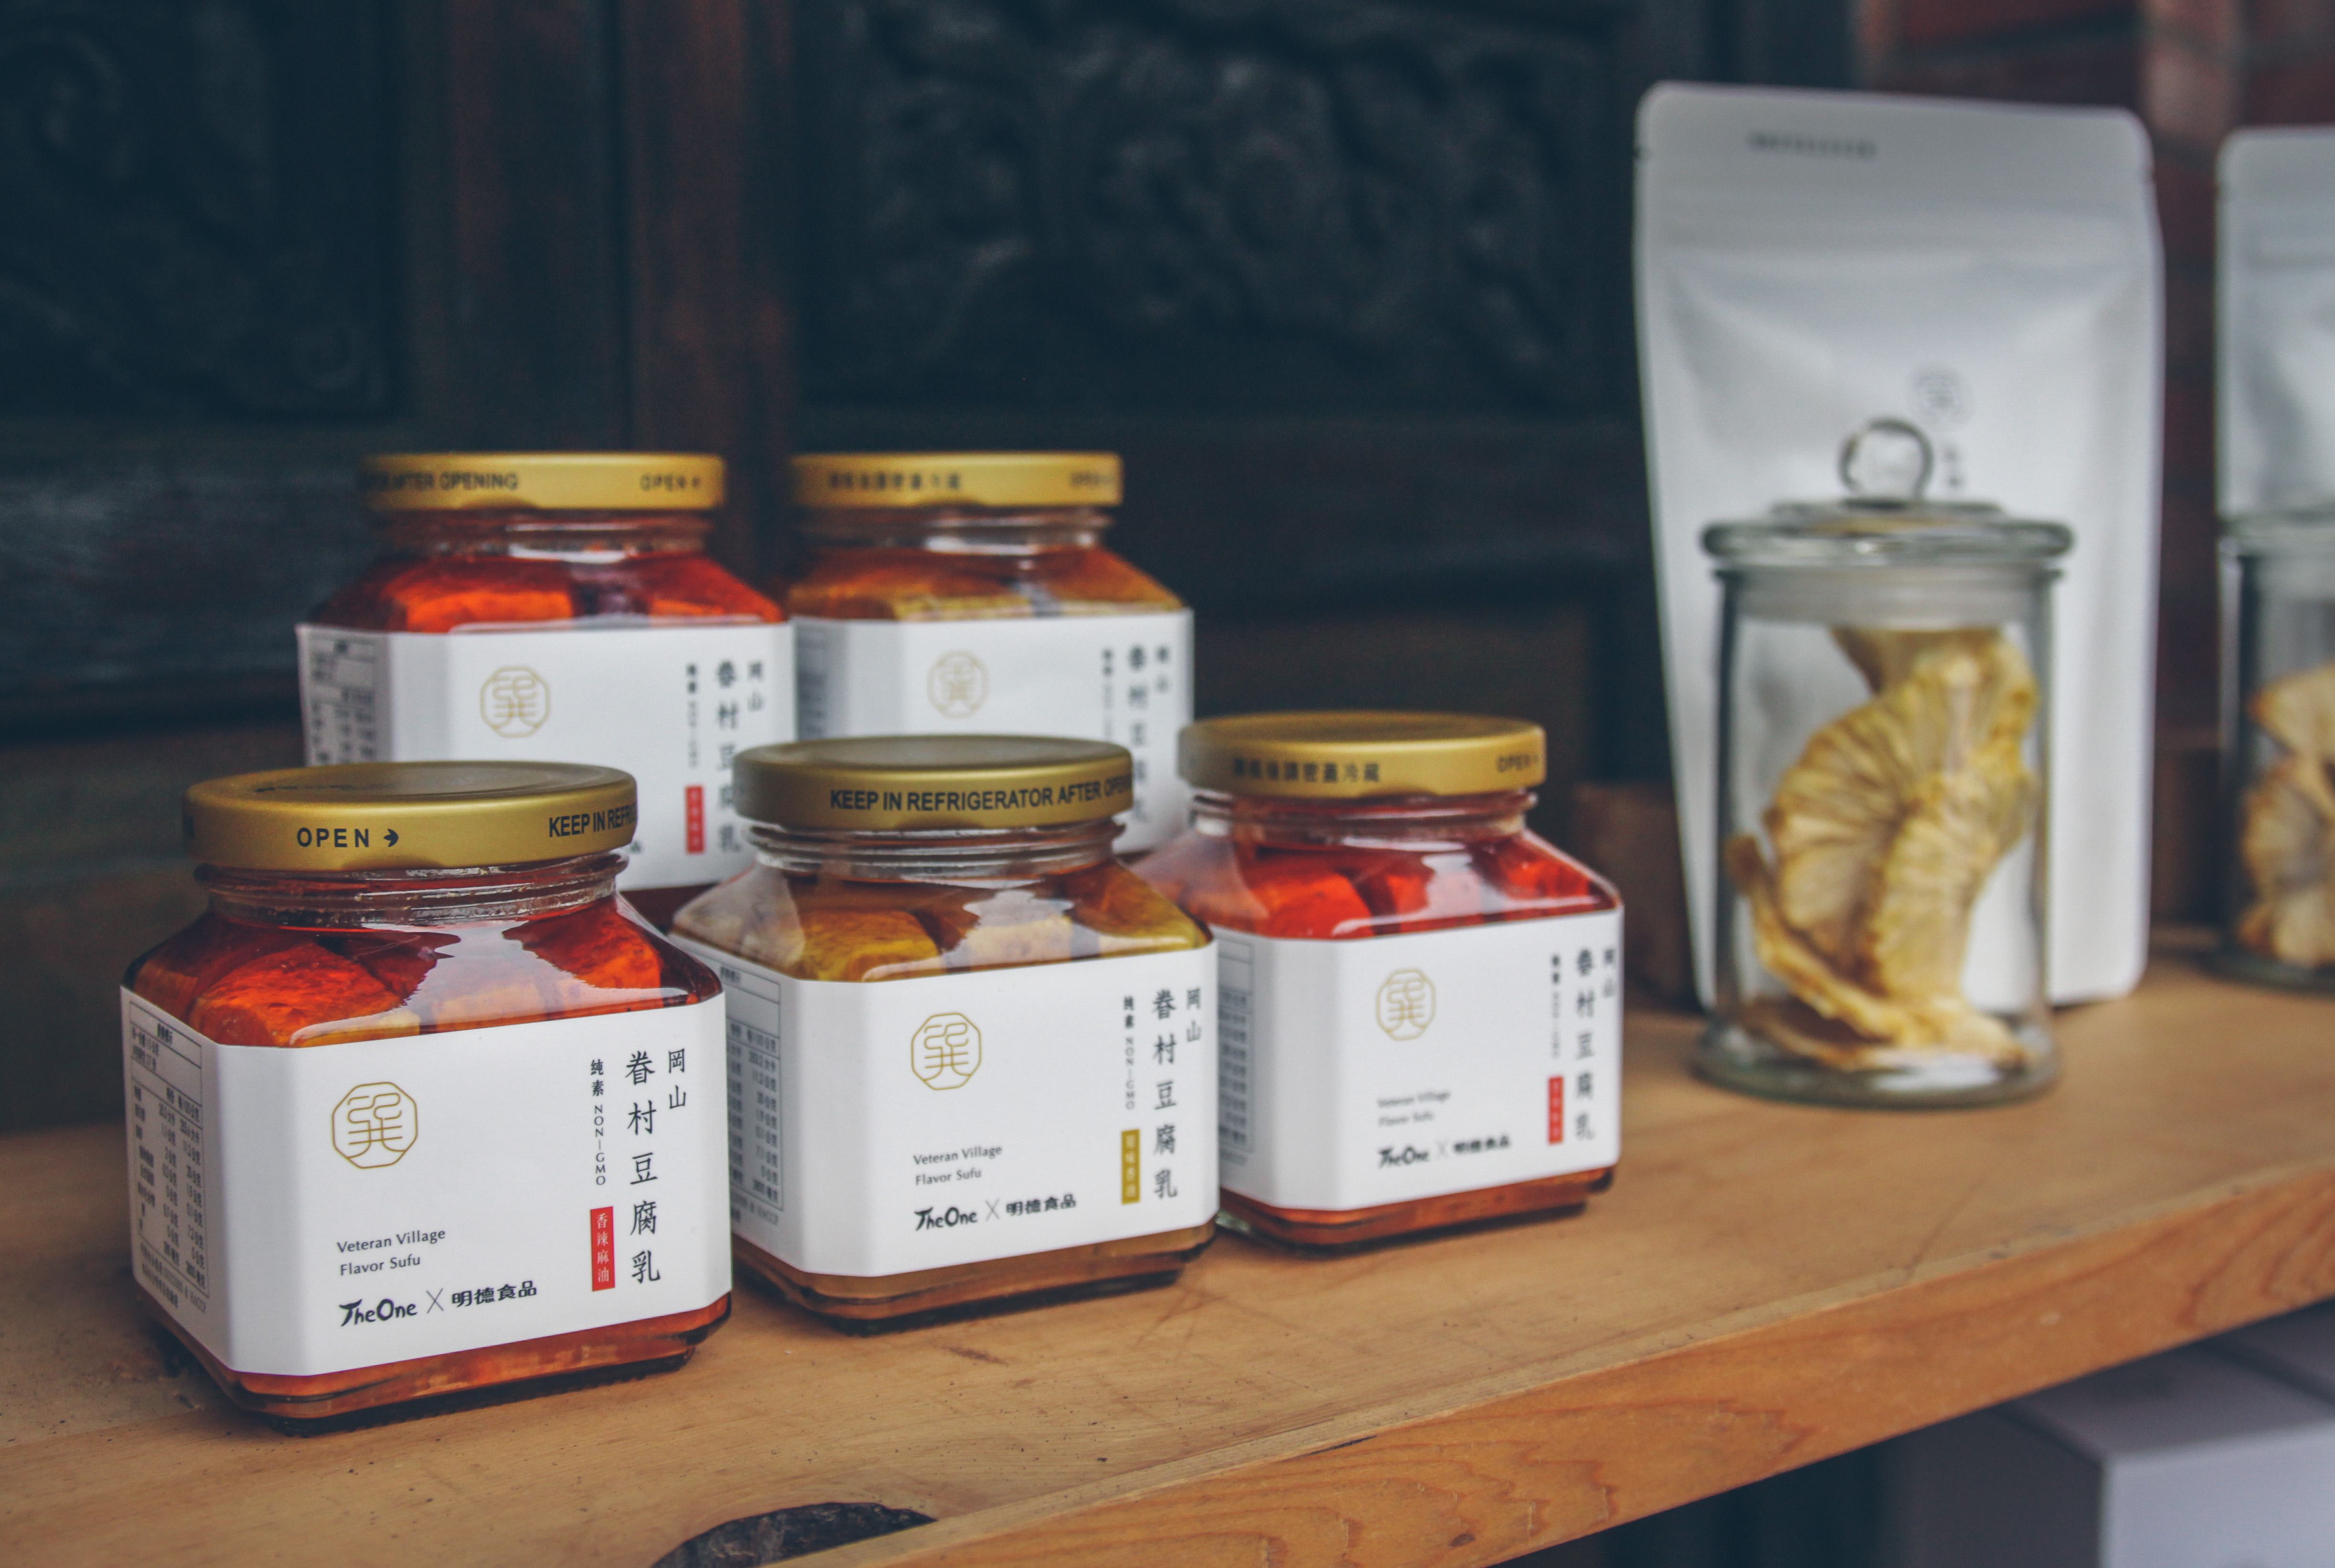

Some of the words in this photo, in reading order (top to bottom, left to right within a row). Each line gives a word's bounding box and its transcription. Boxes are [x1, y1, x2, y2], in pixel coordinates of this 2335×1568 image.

[830, 789, 878, 810] KEEP
[883, 790, 903, 811] IN
[907, 787, 1053, 811] REFRIGERATOR
[1057, 780, 1102, 805] AFTER
[297, 827, 370, 848] OPEN
[549, 813, 590, 837] KEEP
[593, 811, 605, 832] IN
[590, 1058, 604, 1097] 純素
[668, 1048, 686, 1109] 岡山
[625, 1050, 661, 1284] 眷村豆腐乳
[913, 1152, 959, 1165] Veteran
[962, 1146, 1003, 1159] Village
[915, 1173, 952, 1186] Flavor
[956, 1167, 982, 1181] Sufu
[337, 1238, 392, 1253] Veteran
[396, 1229, 446, 1244] Village
[597, 1213, 610, 1283] 香辣麻油
[340, 1262, 384, 1276] Flavor
[390, 1253, 421, 1269] Sufu
[451, 1280, 537, 1308] 明德食品
[338, 1298, 418, 1327] TheOne
